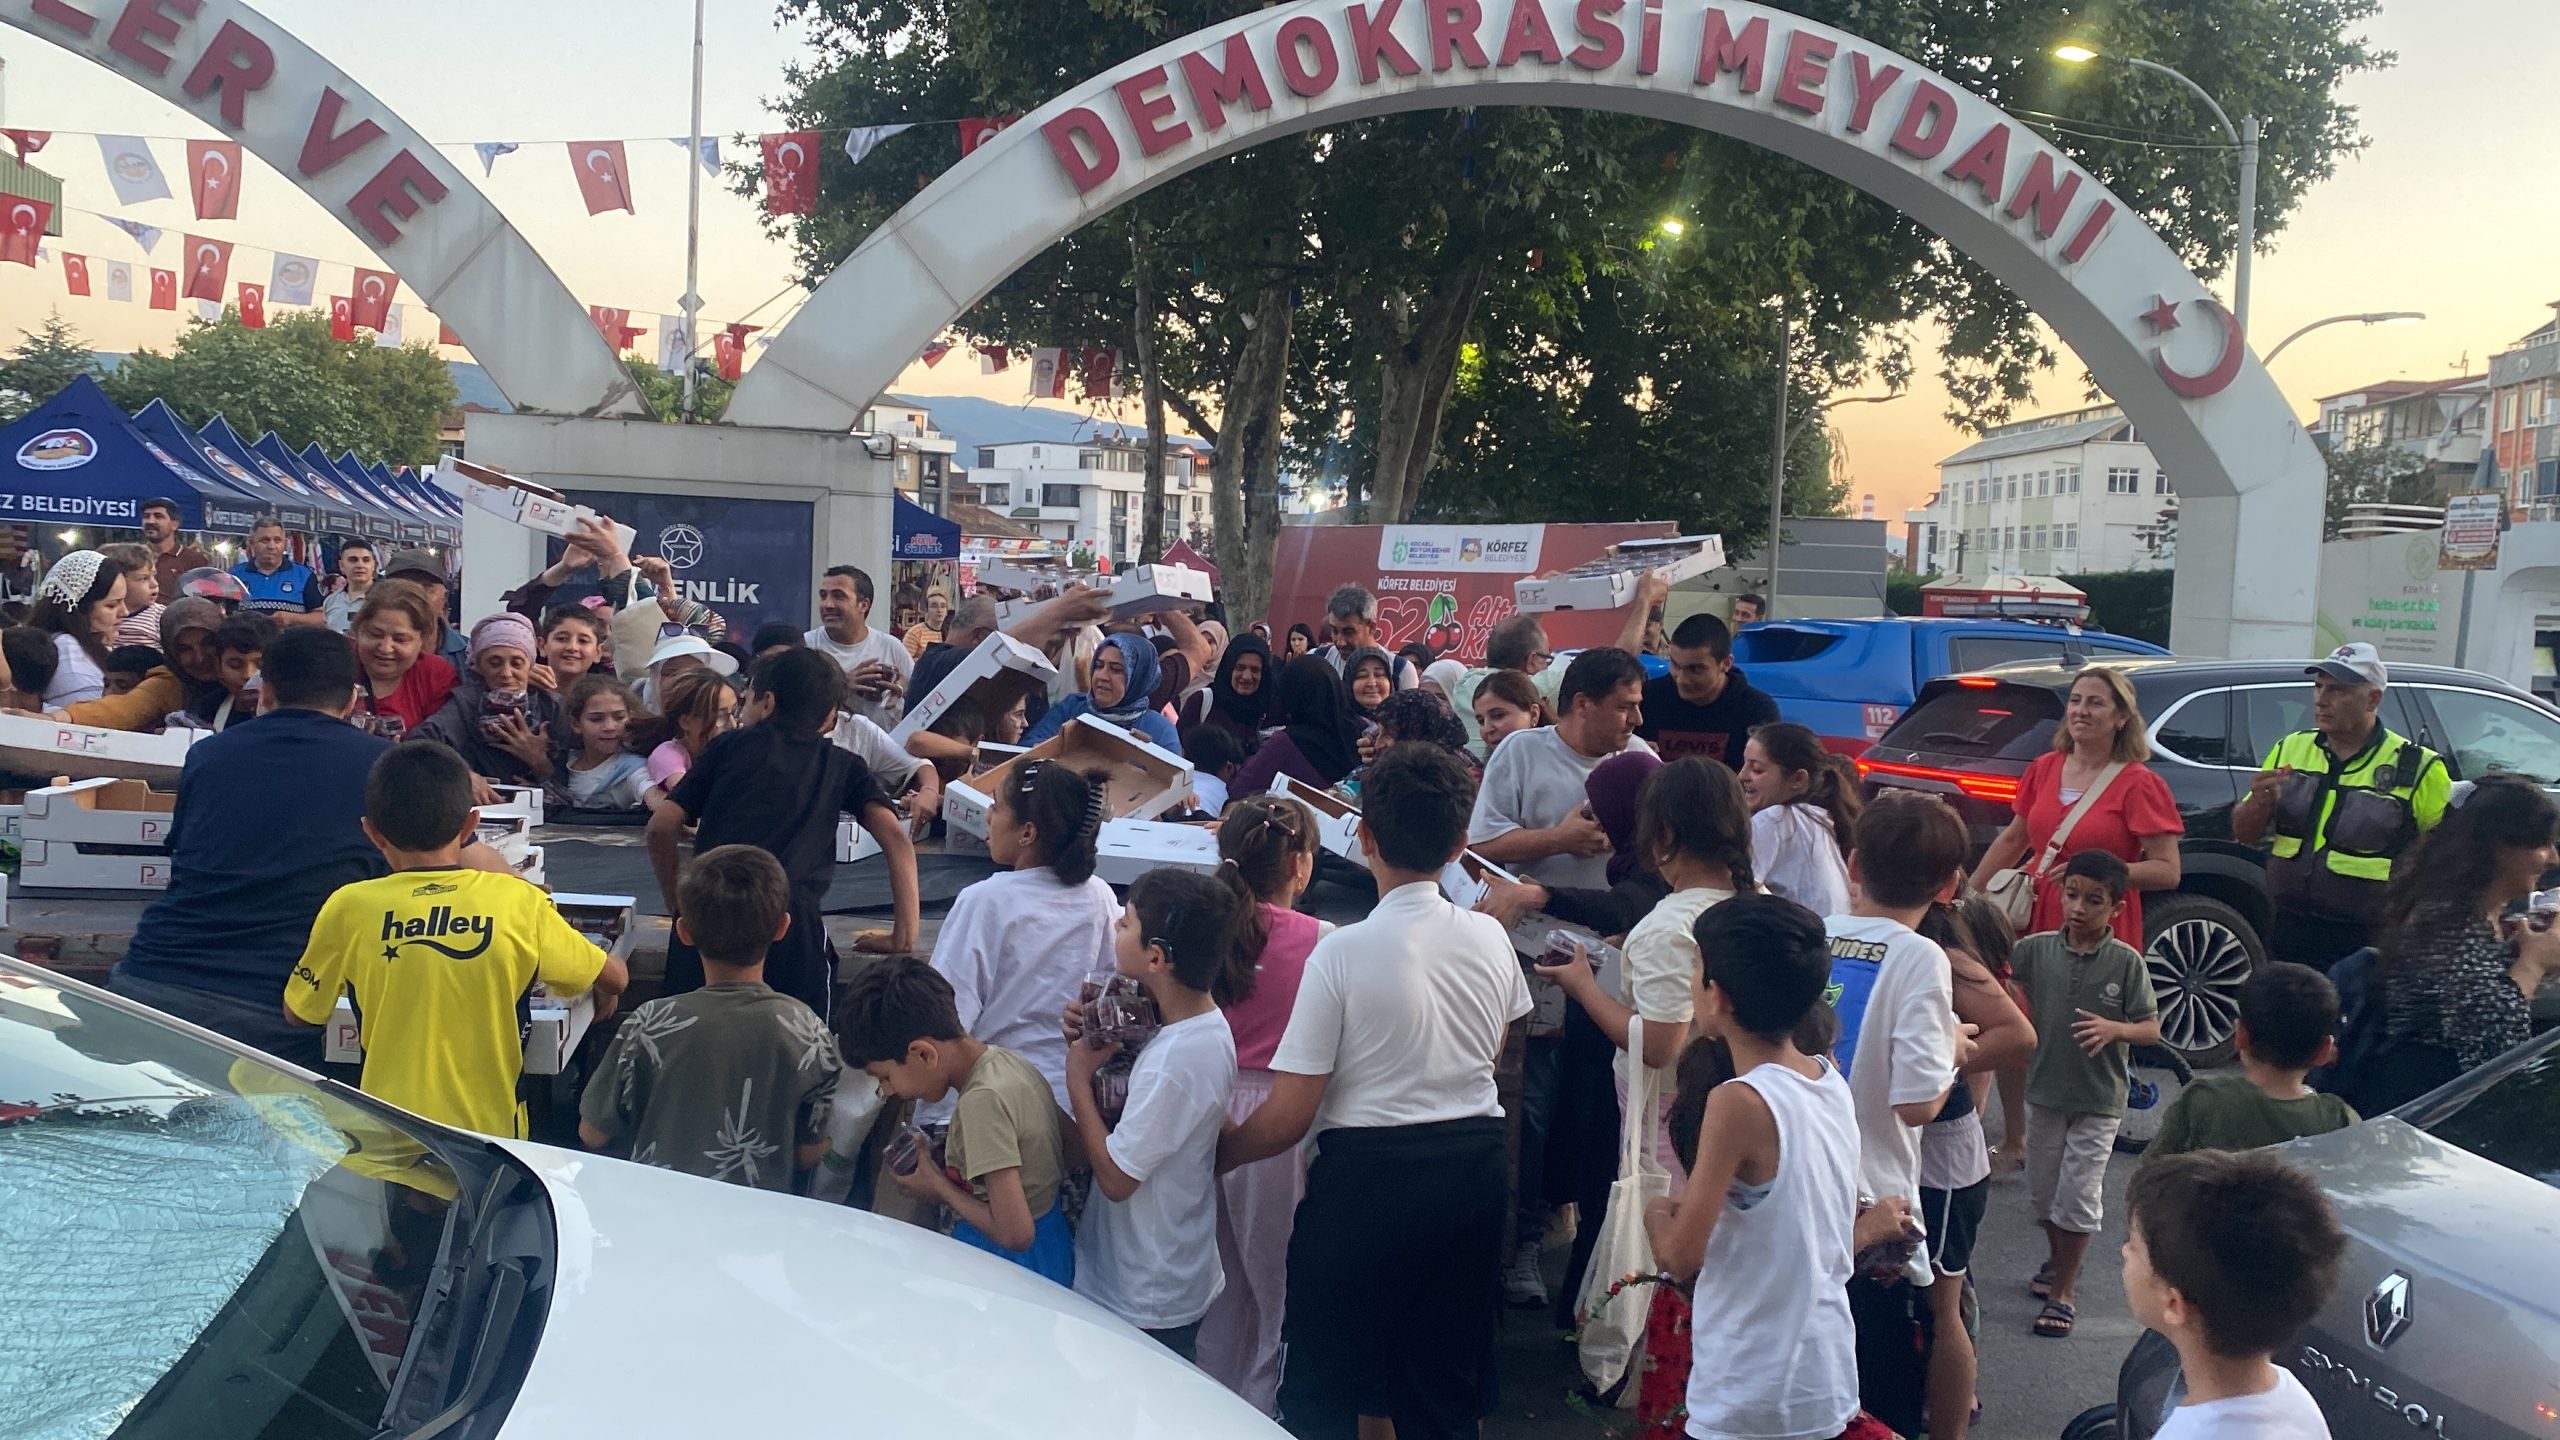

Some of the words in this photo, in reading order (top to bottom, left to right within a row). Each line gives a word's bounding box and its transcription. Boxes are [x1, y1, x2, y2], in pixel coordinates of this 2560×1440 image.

[29, 0, 275, 129] ER
[297, 85, 450, 247] VE
[1042, 0, 1664, 193] DEMOKRASİ
[1695, 8, 2116, 263] MEYDANI
[21, 495, 137, 518] BELEDİYESİ
[904, 541, 943, 555] sanat
[1484, 552, 1527, 562] BELEDİYESİ
[1486, 539, 1529, 553] KÖRFEZ
[672, 577, 761, 605] ENLİK
[1377, 576, 1408, 591] KÖRFEZ
[1409, 577, 1457, 592] BELEDİYESİ
[1867, 707, 1895, 725] 112
[381, 906, 494, 960] halley
[1831, 936, 1888, 964] VIBES
